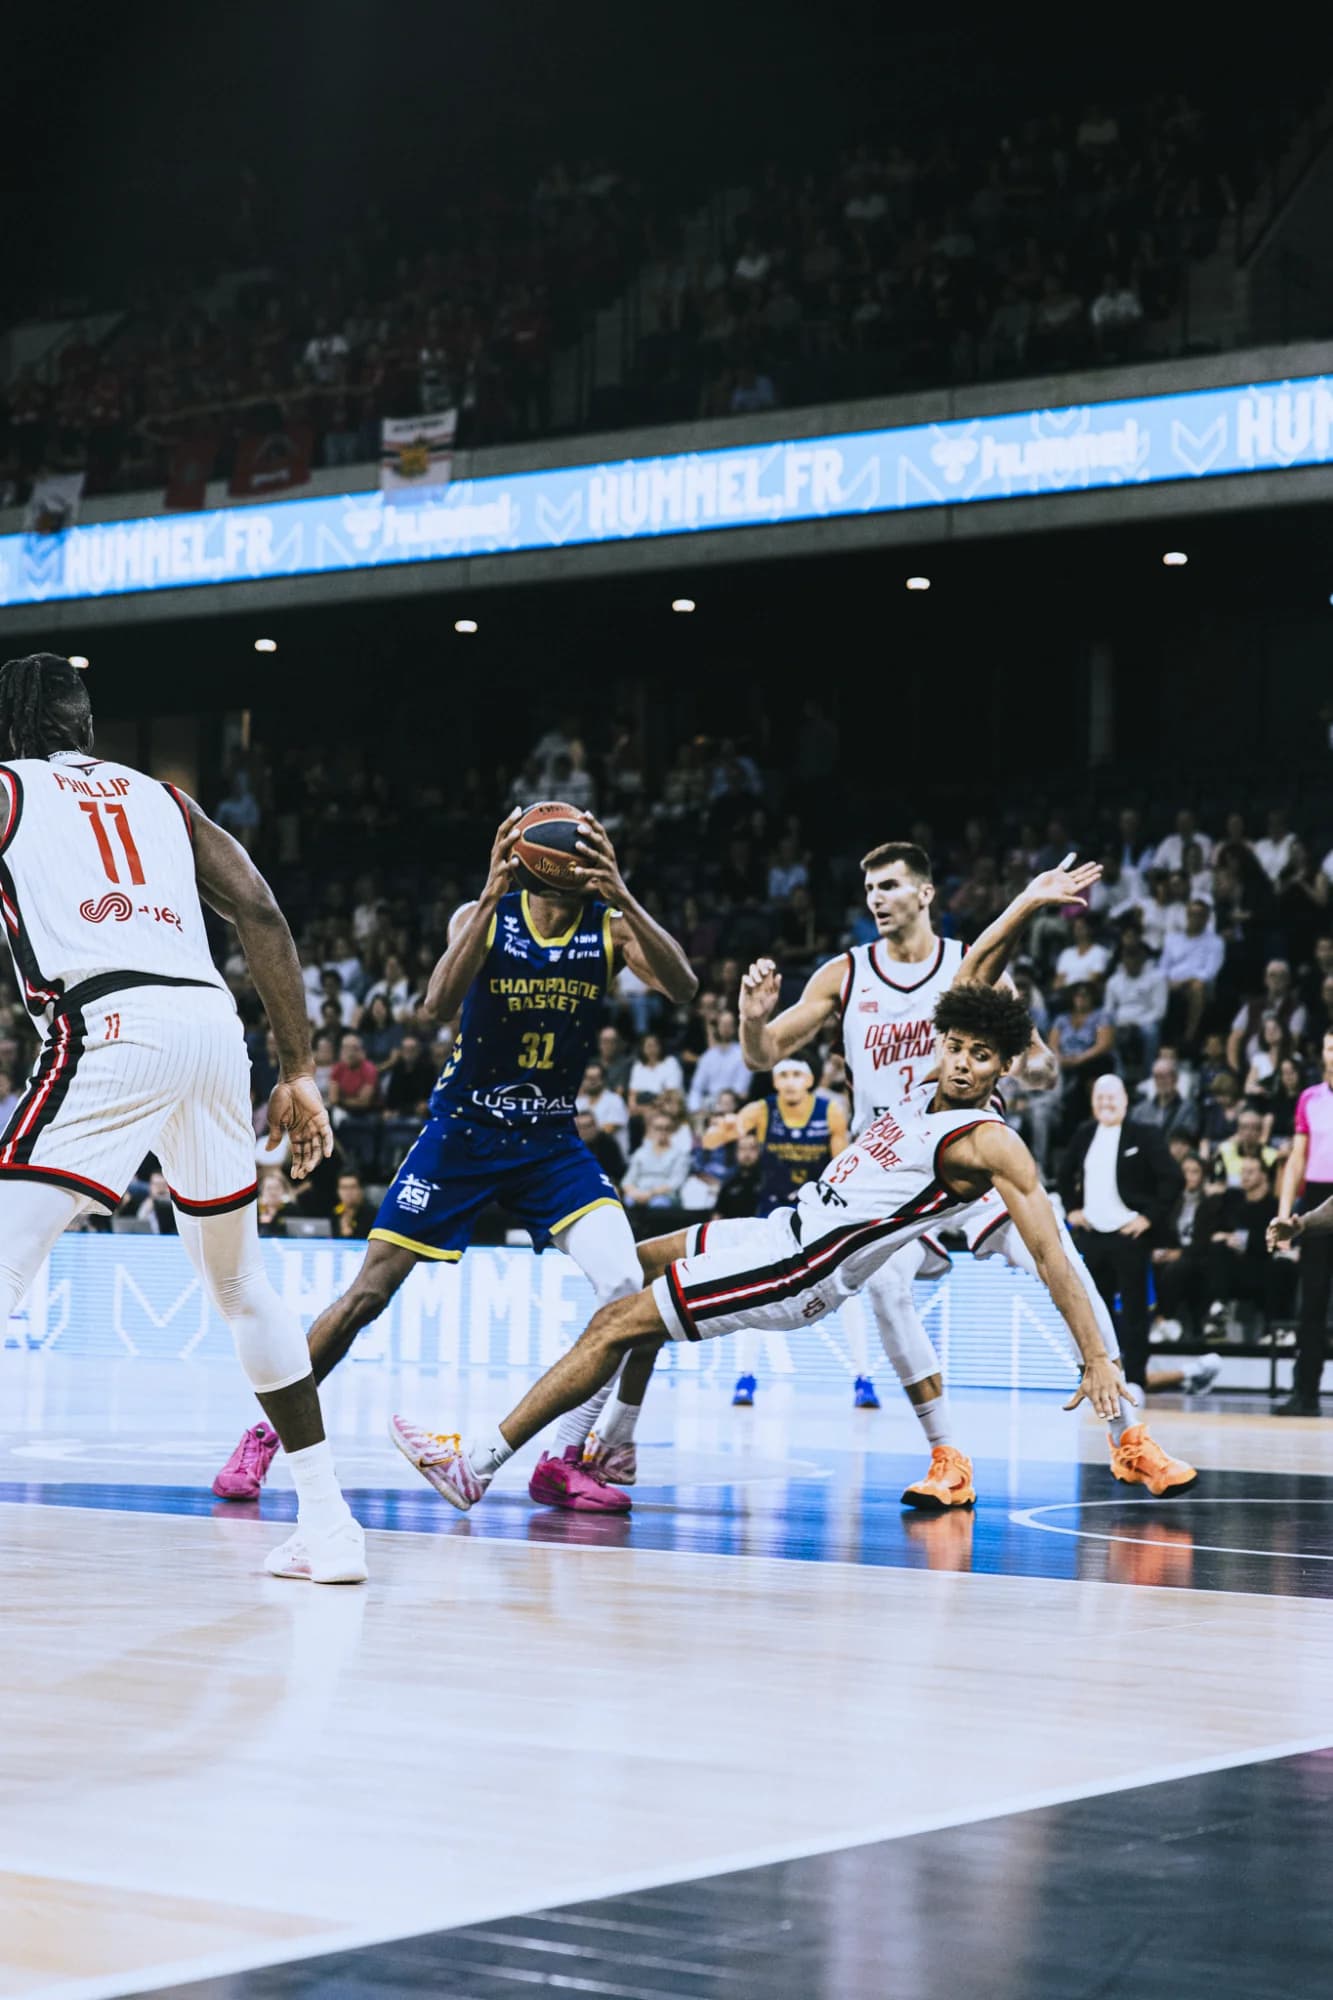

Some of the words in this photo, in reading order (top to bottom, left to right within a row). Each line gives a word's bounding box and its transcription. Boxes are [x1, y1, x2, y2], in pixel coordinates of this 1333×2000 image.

[588, 448, 844, 532] HUMMEL.FR
[64, 516, 274, 592] HUMMEL.FR
[53, 773, 130, 797] PHILLIP
[79, 801, 146, 885] 11
[490, 977, 599, 1000] CHAMPAGNE
[508, 994, 580, 1013] BASKET
[104, 1013, 120, 1040] 11
[864, 1019, 931, 1050] DENAIN
[518, 1031, 555, 1069] 31
[471, 1090, 574, 1111] LUSTRAL
[397, 1185, 430, 1208] ASI
